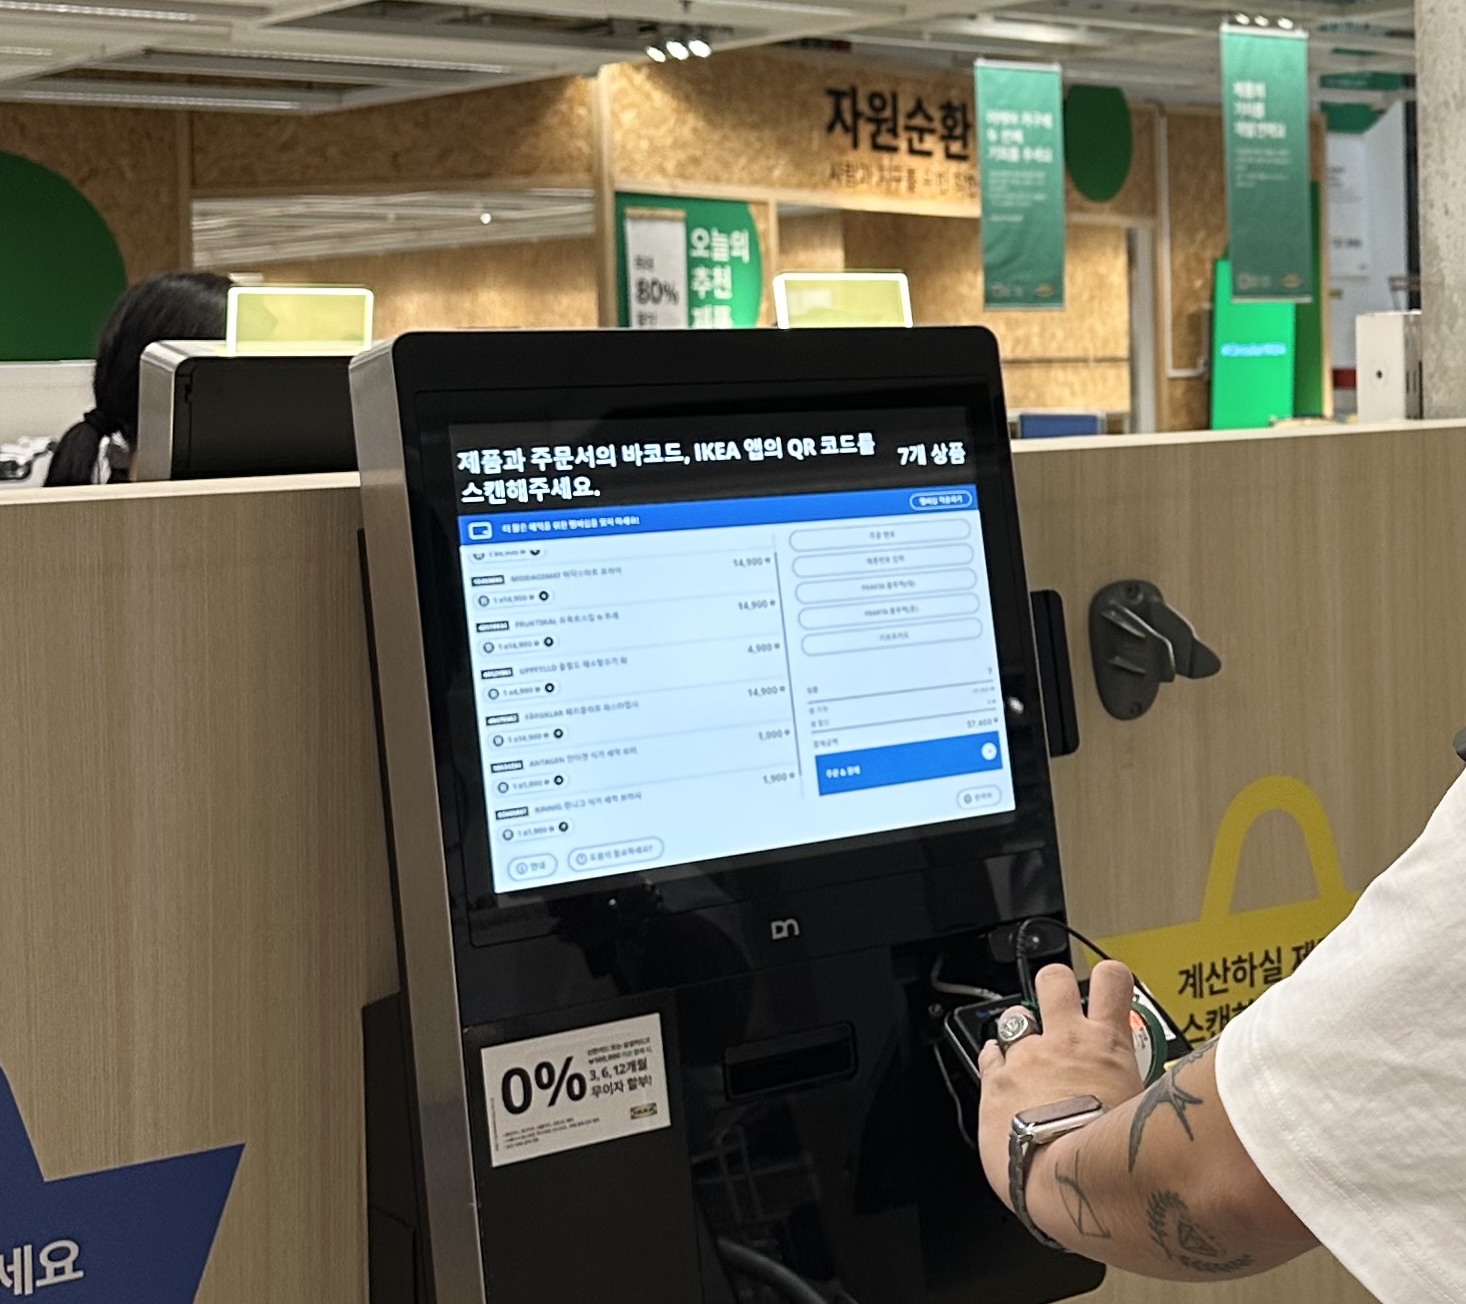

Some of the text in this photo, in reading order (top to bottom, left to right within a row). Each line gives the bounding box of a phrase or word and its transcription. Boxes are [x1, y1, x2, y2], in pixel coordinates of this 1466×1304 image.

[825, 86, 971, 161] 자원순환
[690, 227, 750, 263] 오늘의
[636, 276, 680, 306] 80%
[690, 264, 733, 300] 추천
[456, 432, 876, 476] 제품과 주문서의 바코드, IKEA 앱의 QR 코드를
[896, 441, 966, 466] 7개 상품
[460, 475, 601, 505] 스캔해주세요.
[1177, 945, 1283, 999] 계산하실
[501, 1055, 588, 1116] 0%
[589, 1055, 648, 1082] 3, 6, 12개월
[591, 1074, 652, 1098] 무이자 할부!
